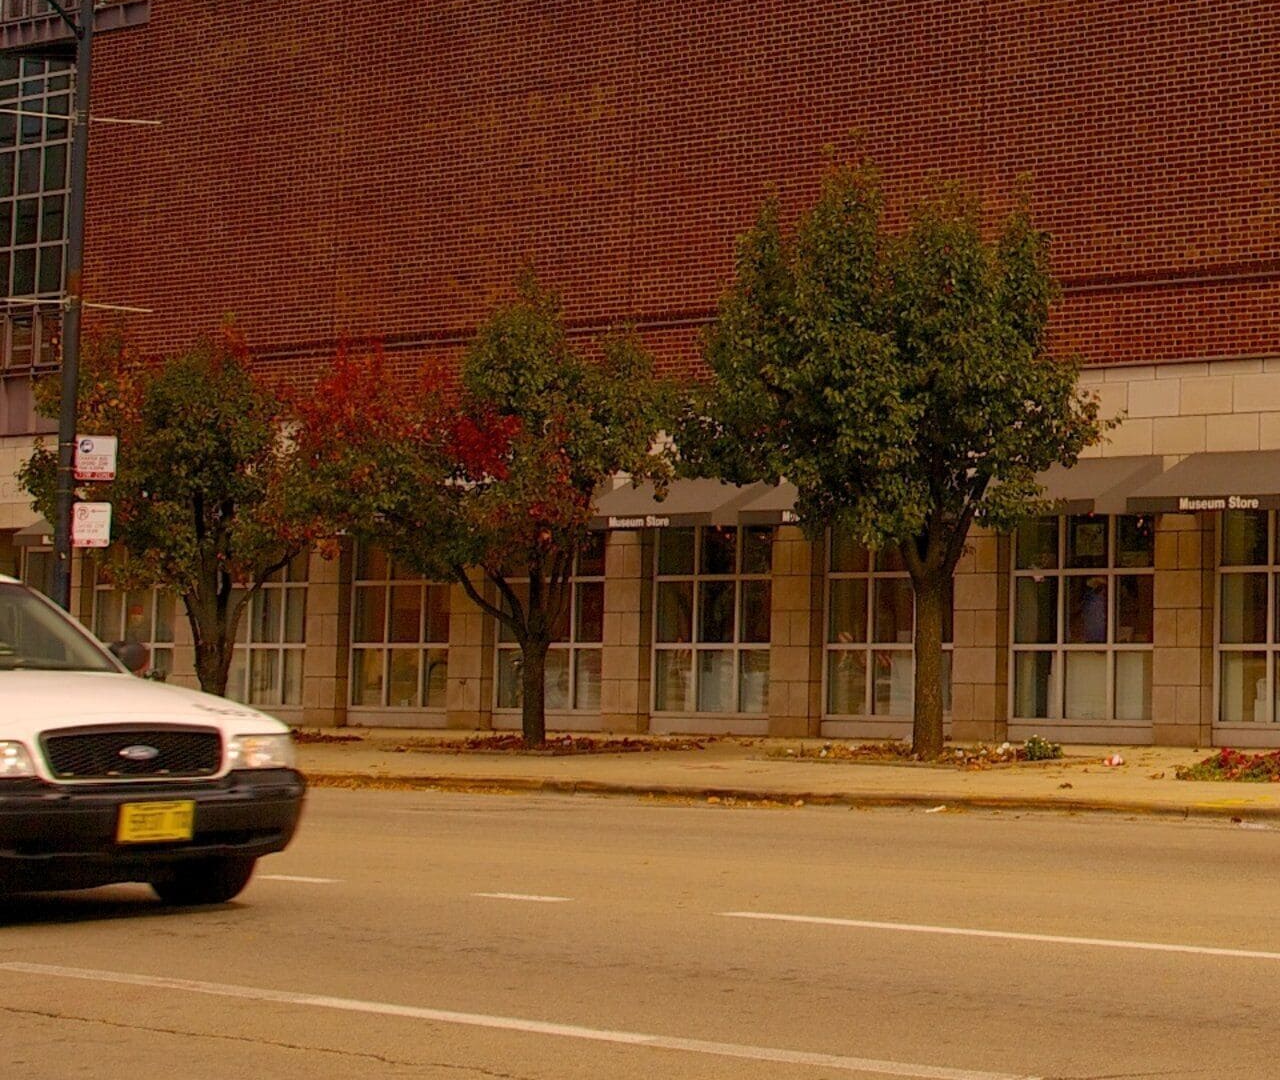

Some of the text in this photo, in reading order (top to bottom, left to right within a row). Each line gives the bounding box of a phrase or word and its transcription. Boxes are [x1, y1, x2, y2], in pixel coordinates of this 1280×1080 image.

[1179, 496, 1259, 510] Museum Store
[646, 515, 670, 527] Store
